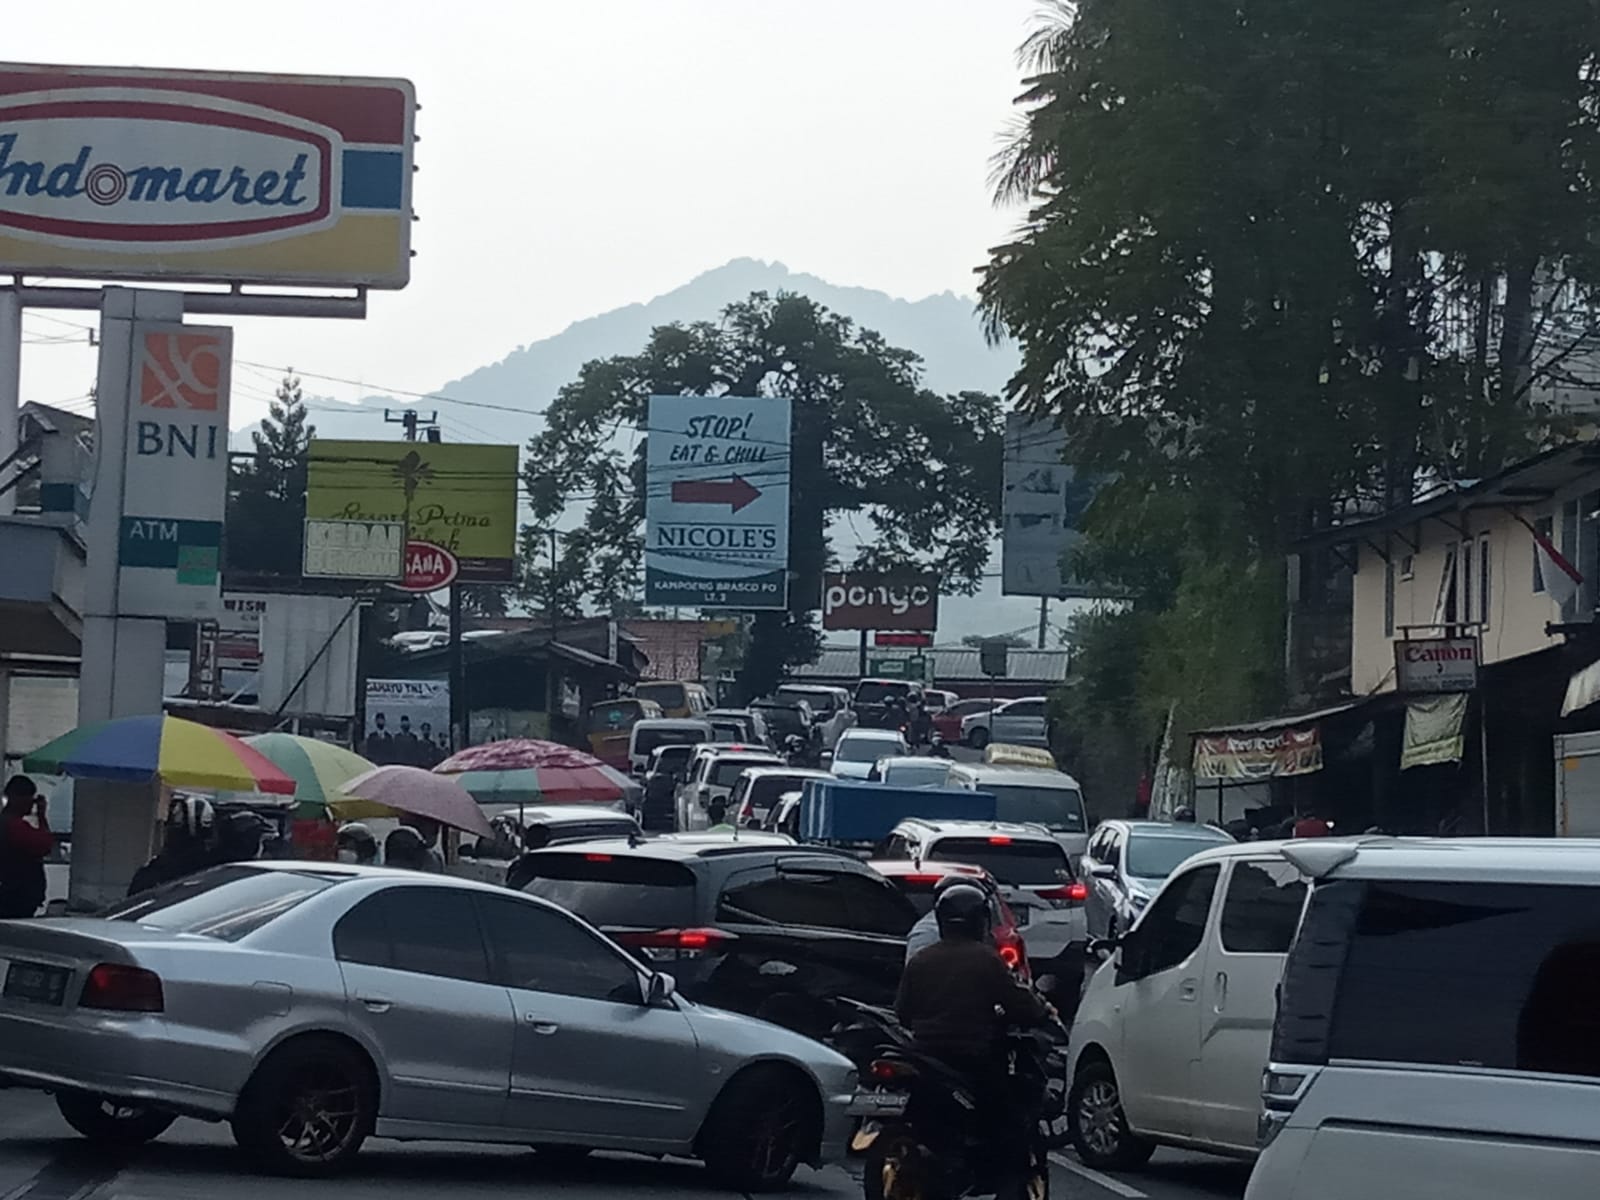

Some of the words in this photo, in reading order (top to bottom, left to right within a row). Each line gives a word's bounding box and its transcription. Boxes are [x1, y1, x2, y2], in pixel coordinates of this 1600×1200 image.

[687, 412, 753, 439] STOP!
[137, 421, 217, 459] BNI
[670, 445, 702, 461] EAT
[704, 446, 719, 463] &
[725, 446, 766, 463] CHILL
[130, 521, 178, 543] ATM
[657, 527, 776, 548] NICOLE'S
[1405, 646, 1472, 662] Canon
